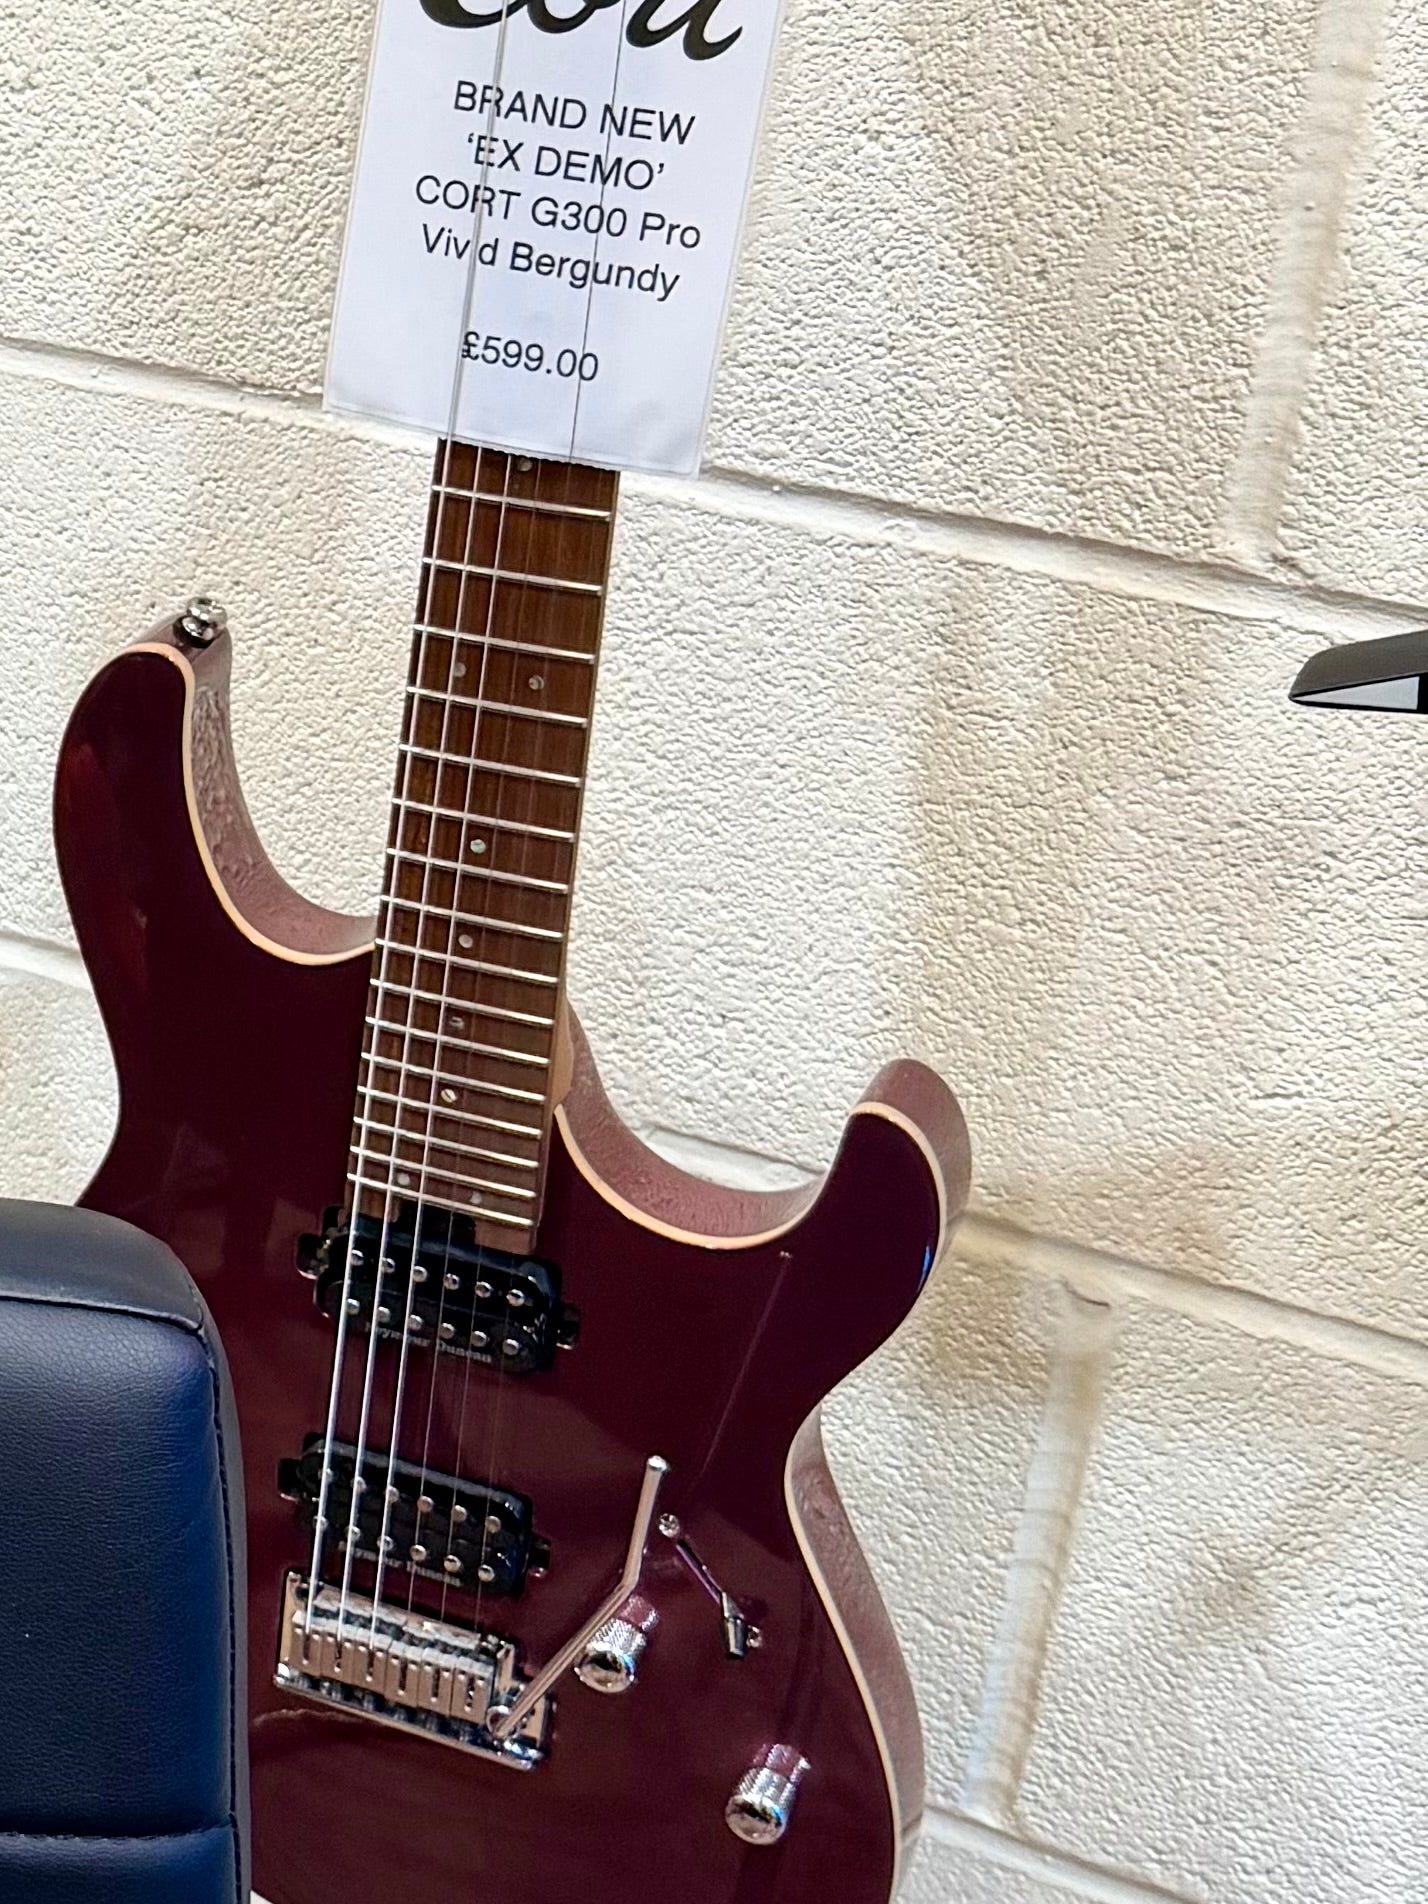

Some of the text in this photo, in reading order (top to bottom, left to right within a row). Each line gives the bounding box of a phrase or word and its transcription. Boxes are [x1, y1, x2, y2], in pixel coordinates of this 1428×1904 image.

[454, 80, 695, 145] BRAND NEW
[415, 174, 701, 249] CORT G300 Pro
[422, 223, 680, 302] Vivd Bergundy
[461, 331, 599, 381] £599.00
